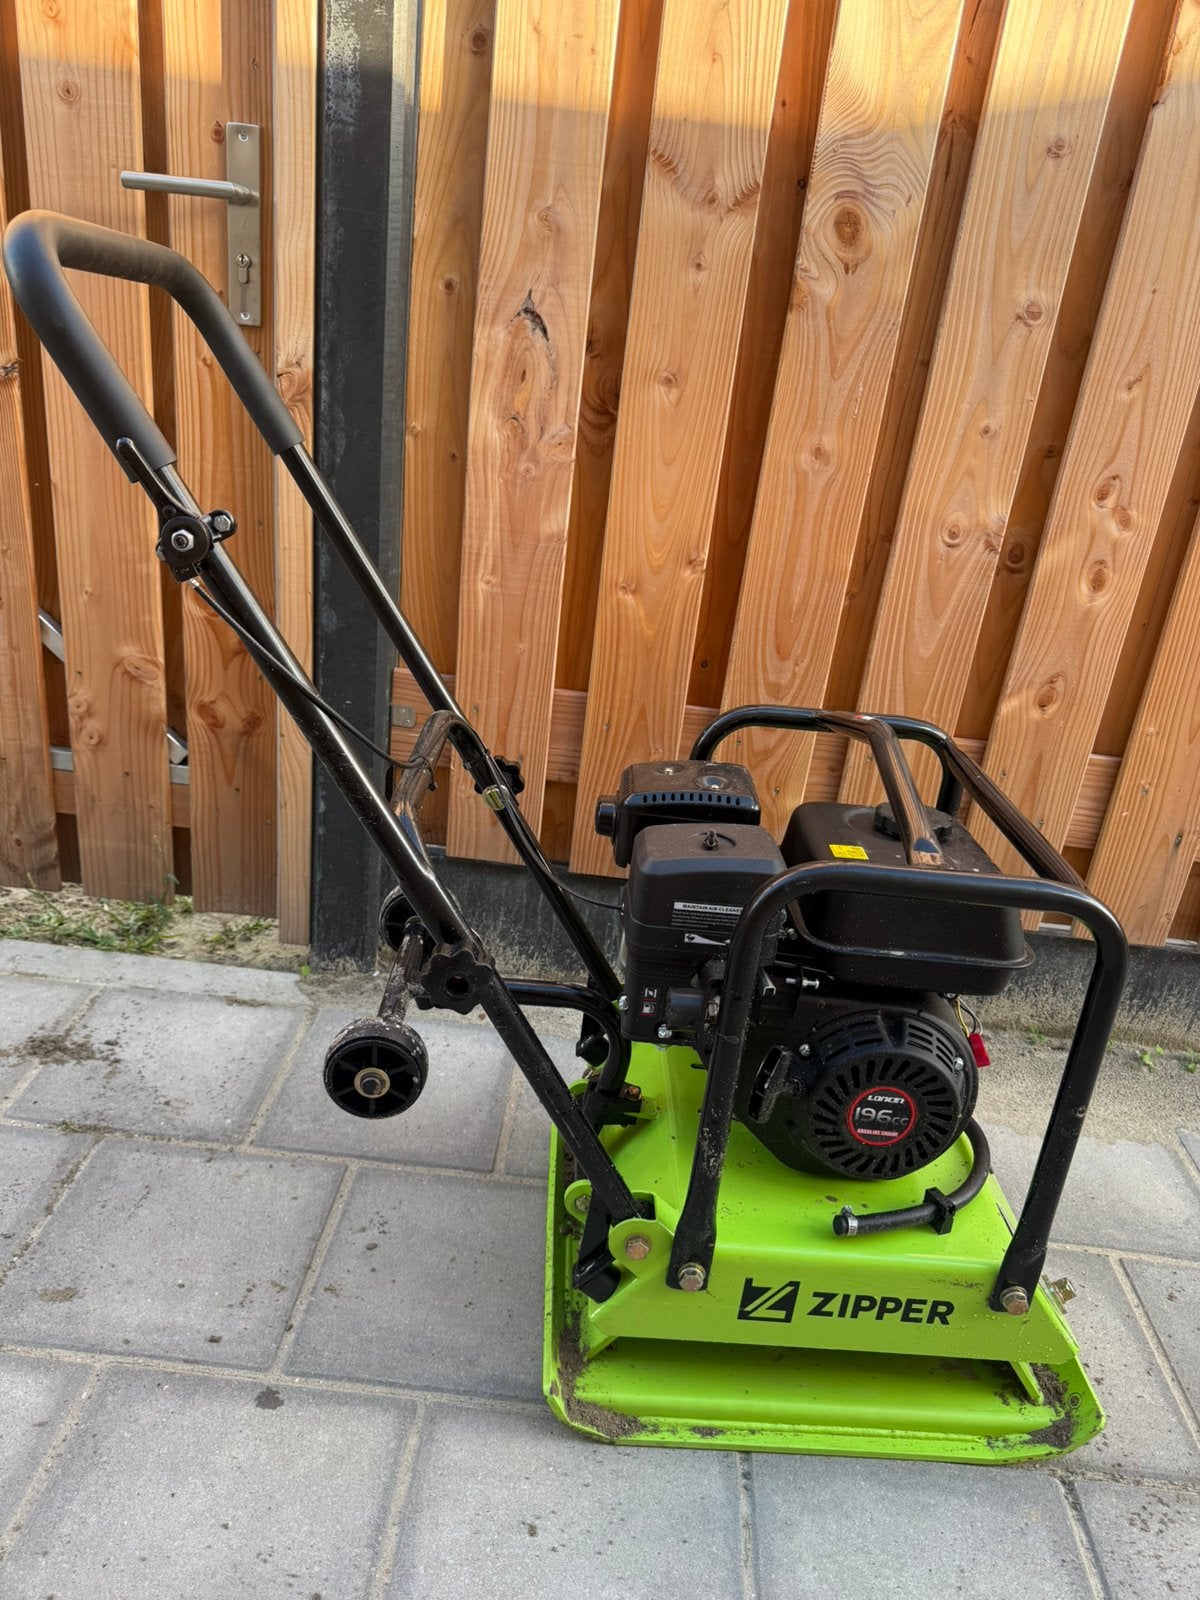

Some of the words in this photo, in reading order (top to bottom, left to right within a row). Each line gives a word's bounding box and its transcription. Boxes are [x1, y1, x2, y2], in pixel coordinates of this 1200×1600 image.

[854, 1107, 909, 1126] 196cc
[857, 1128, 880, 1136] GASOLINE
[807, 1291, 955, 1325] ZIPPER
